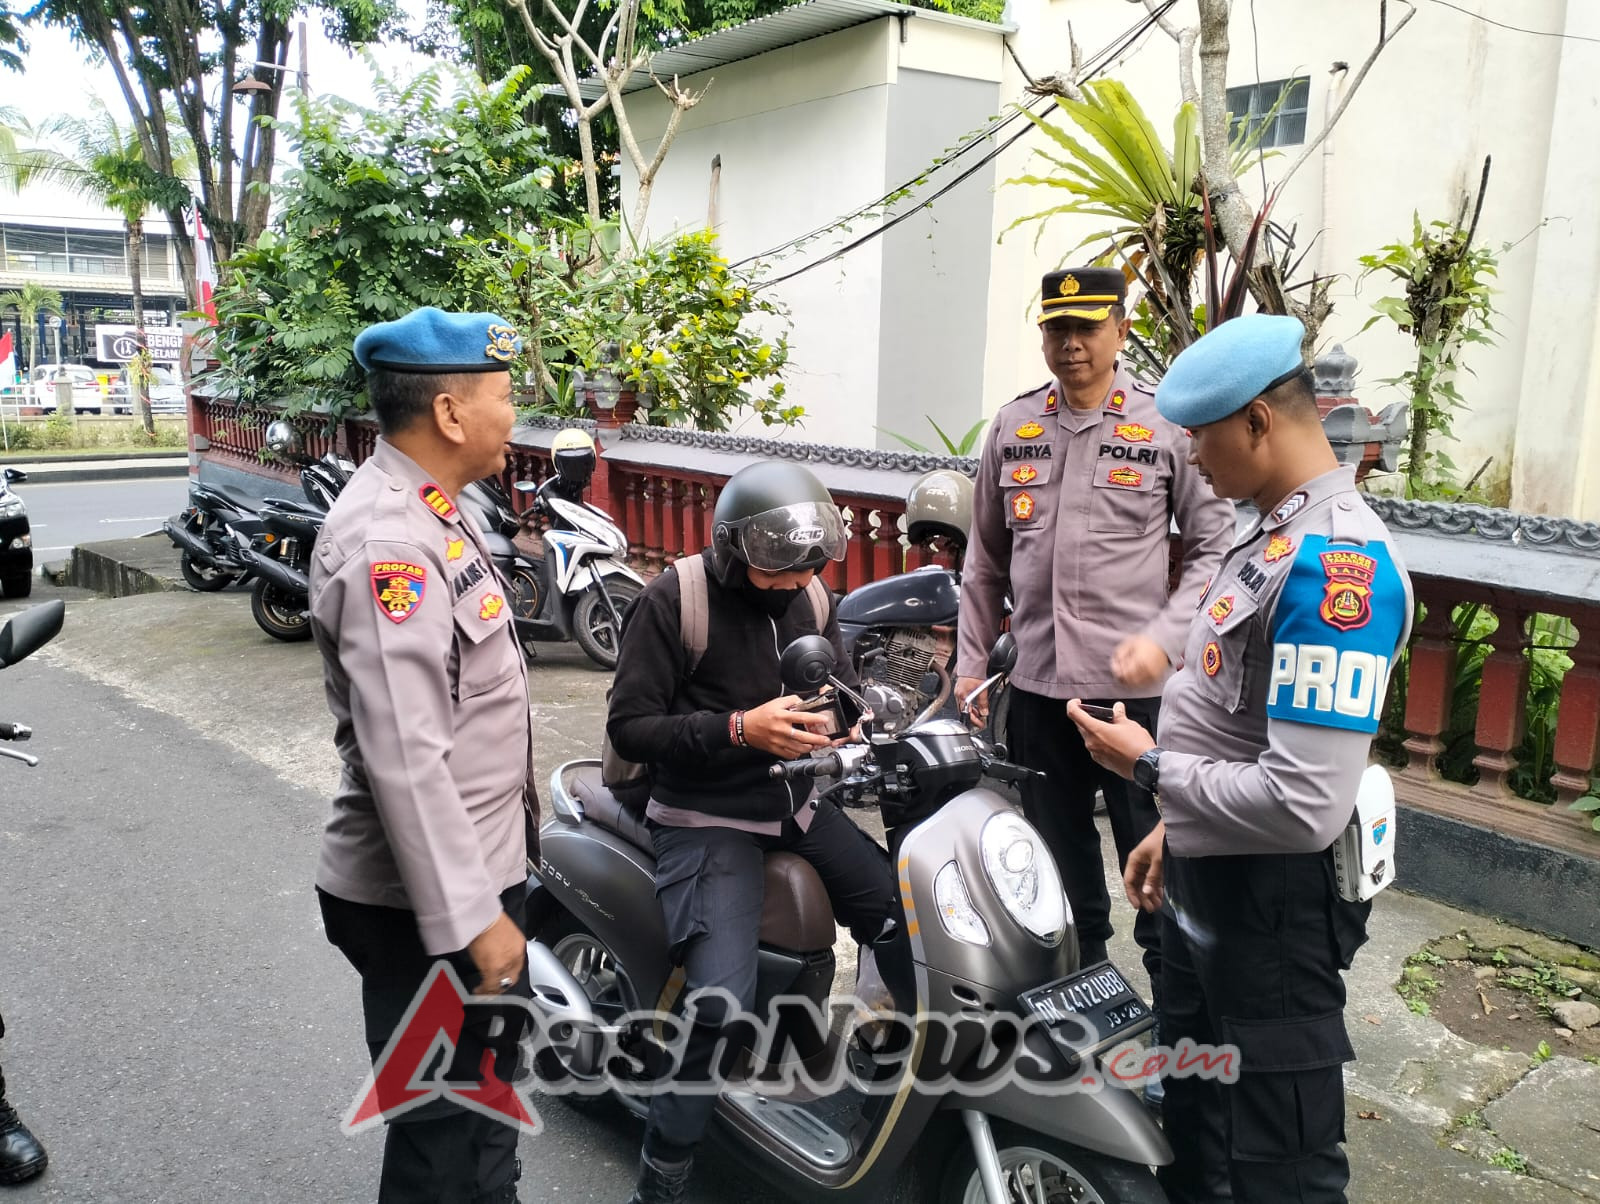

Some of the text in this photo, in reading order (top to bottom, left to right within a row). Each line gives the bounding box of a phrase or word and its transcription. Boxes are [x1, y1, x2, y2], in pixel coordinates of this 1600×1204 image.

[1003, 444, 1052, 460] SURYA
[1099, 444, 1158, 466] POLRI
[374, 563, 423, 577] PROPAM
[1330, 567, 1368, 579] BALI
[1035, 998, 1065, 1025] DK
